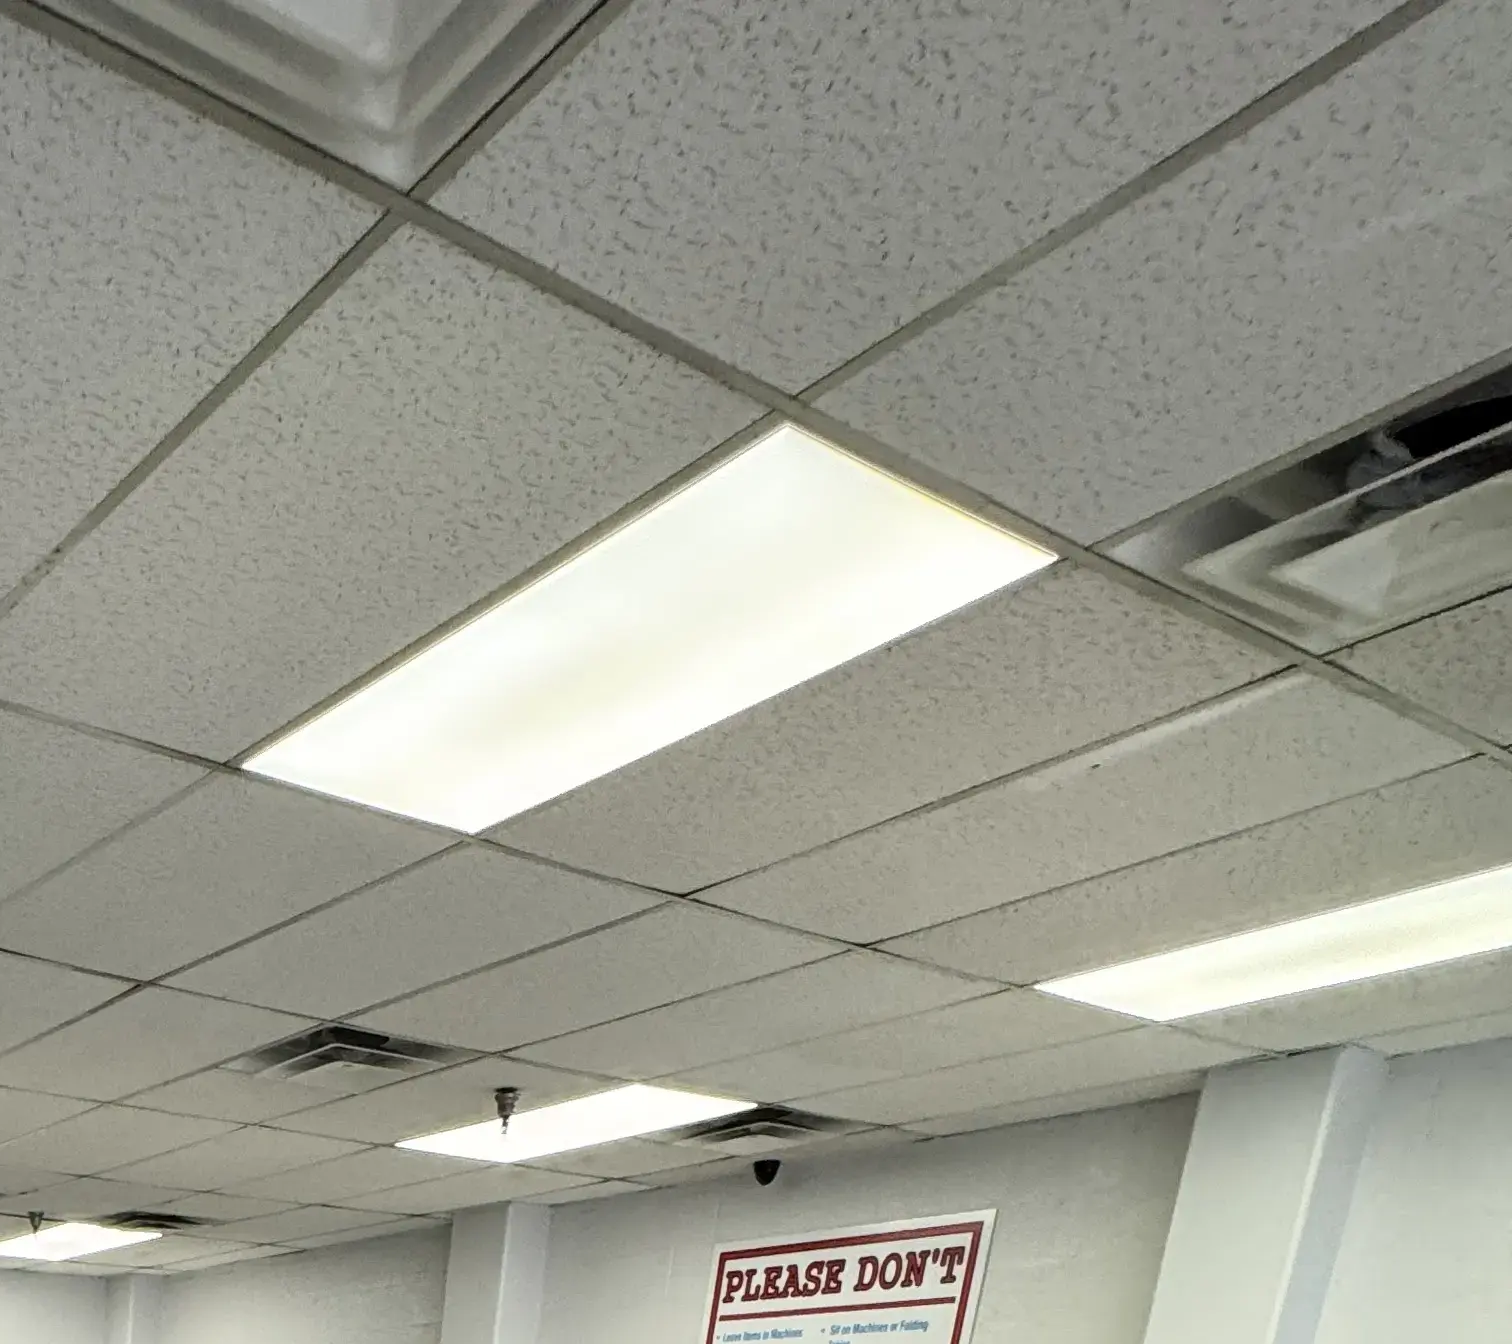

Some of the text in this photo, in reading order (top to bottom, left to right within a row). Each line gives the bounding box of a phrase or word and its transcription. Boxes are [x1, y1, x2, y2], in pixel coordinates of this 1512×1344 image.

[722, 1245, 966, 1304] PLEASE DON'T
[771, 1328, 804, 1340] Machines
[830, 1320, 930, 1336] Sit on Machines or Folding
